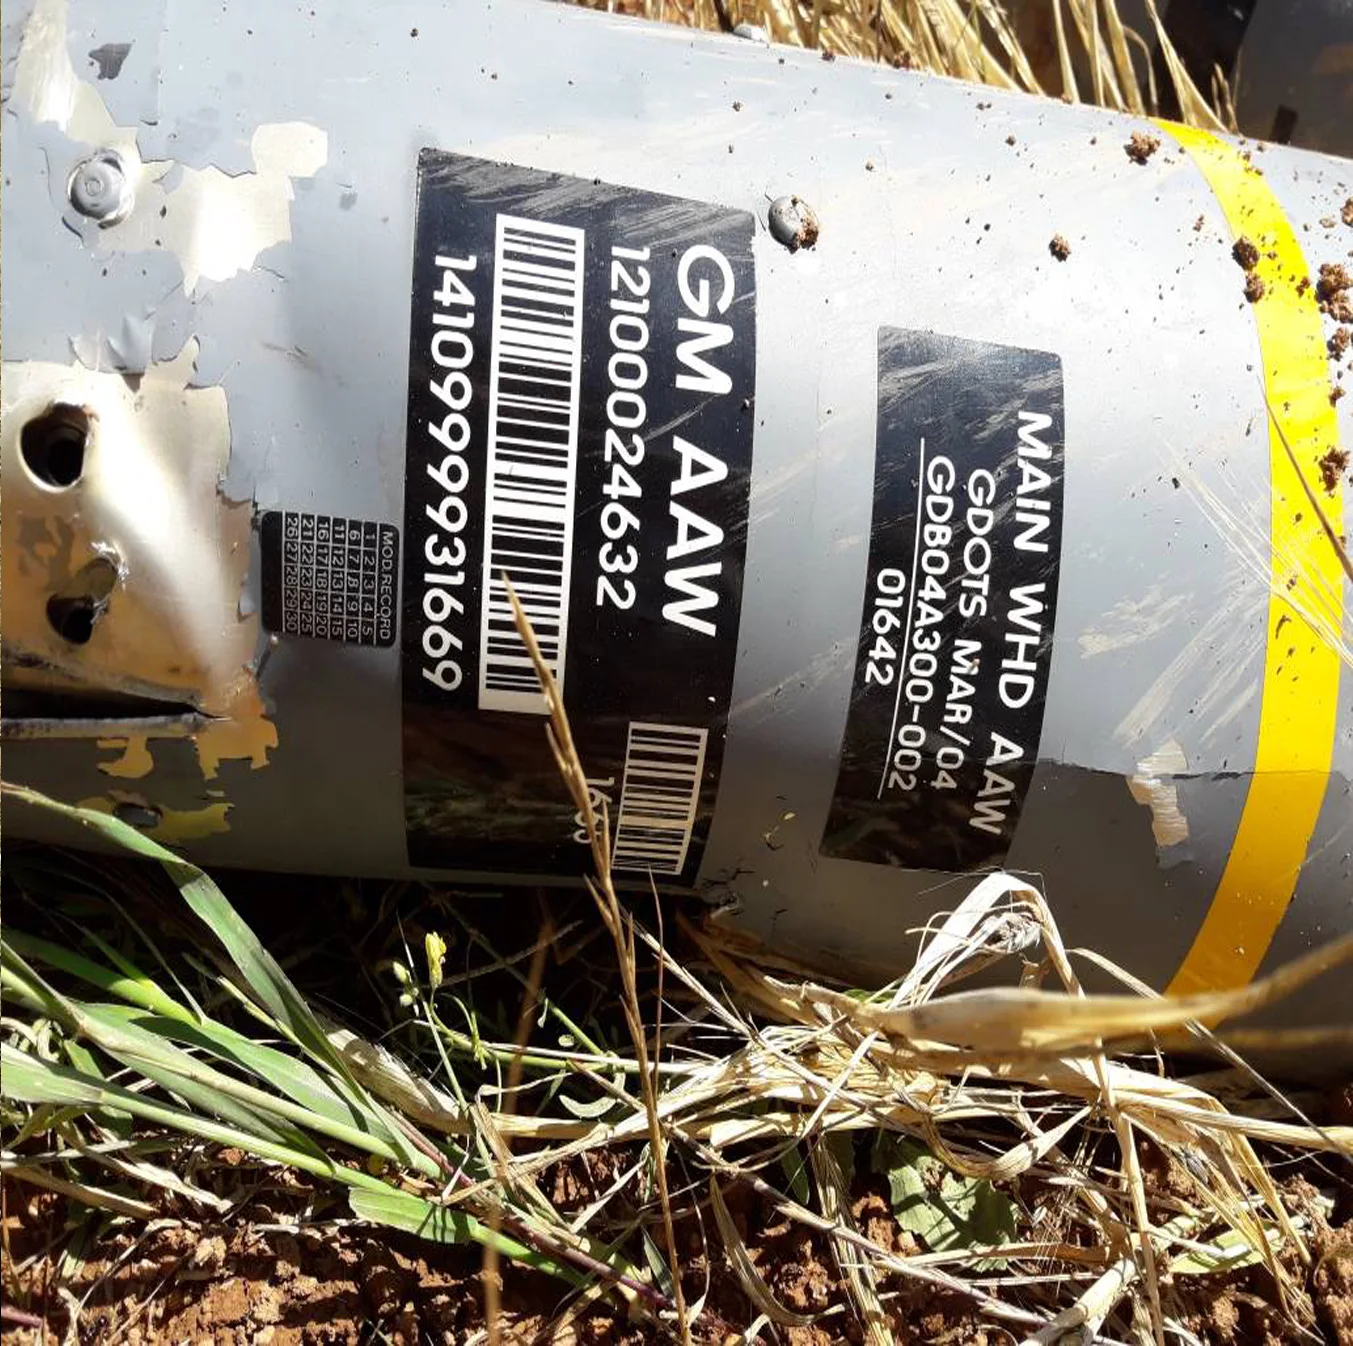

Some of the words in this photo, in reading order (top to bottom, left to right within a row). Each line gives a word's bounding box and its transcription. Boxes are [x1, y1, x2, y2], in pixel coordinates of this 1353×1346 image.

[675, 244, 735, 395] GM
[595, 244, 651, 610] 12100024632
[421, 255, 477, 692] 1410999931669
[1013, 411, 1052, 552] MAIN
[287, 518, 297, 537] 26
[303, 518, 313, 536] 21
[318, 522, 328, 540] 16
[335, 525, 344, 539] 11
[349, 530, 359, 540] 6
[662, 436, 725, 636] AAW
[958, 469, 996, 617] GDOTS
[287, 544, 296, 560] 27
[302, 544, 312, 563] 22
[318, 548, 328, 563] 17
[333, 549, 343, 565] 12
[349, 555, 359, 563] 7
[364, 556, 374, 565] 2
[287, 566, 296, 584] 28
[302, 567, 311, 586] 23
[317, 572, 326, 587] 18
[332, 573, 343, 588] 13
[348, 577, 358, 588] 8
[364, 580, 374, 589] 3
[287, 590, 296, 607] 29
[302, 592, 311, 609] 24
[317, 596, 326, 611] 19
[332, 597, 342, 612] 14
[348, 602, 358, 611] 9
[364, 603, 373, 612] 4
[287, 612, 296, 630] 30
[302, 614, 311, 632] 25
[317, 616, 326, 634] 20
[332, 621, 342, 635] 15
[864, 568, 907, 686] 01642
[887, 456, 955, 791] GDB04A300-002
[348, 623, 357, 637] 10
[362, 626, 372, 635] 5
[997, 583, 1046, 709] WHD
[930, 639, 980, 790] MAR/04
[968, 731, 1023, 835] AAW
